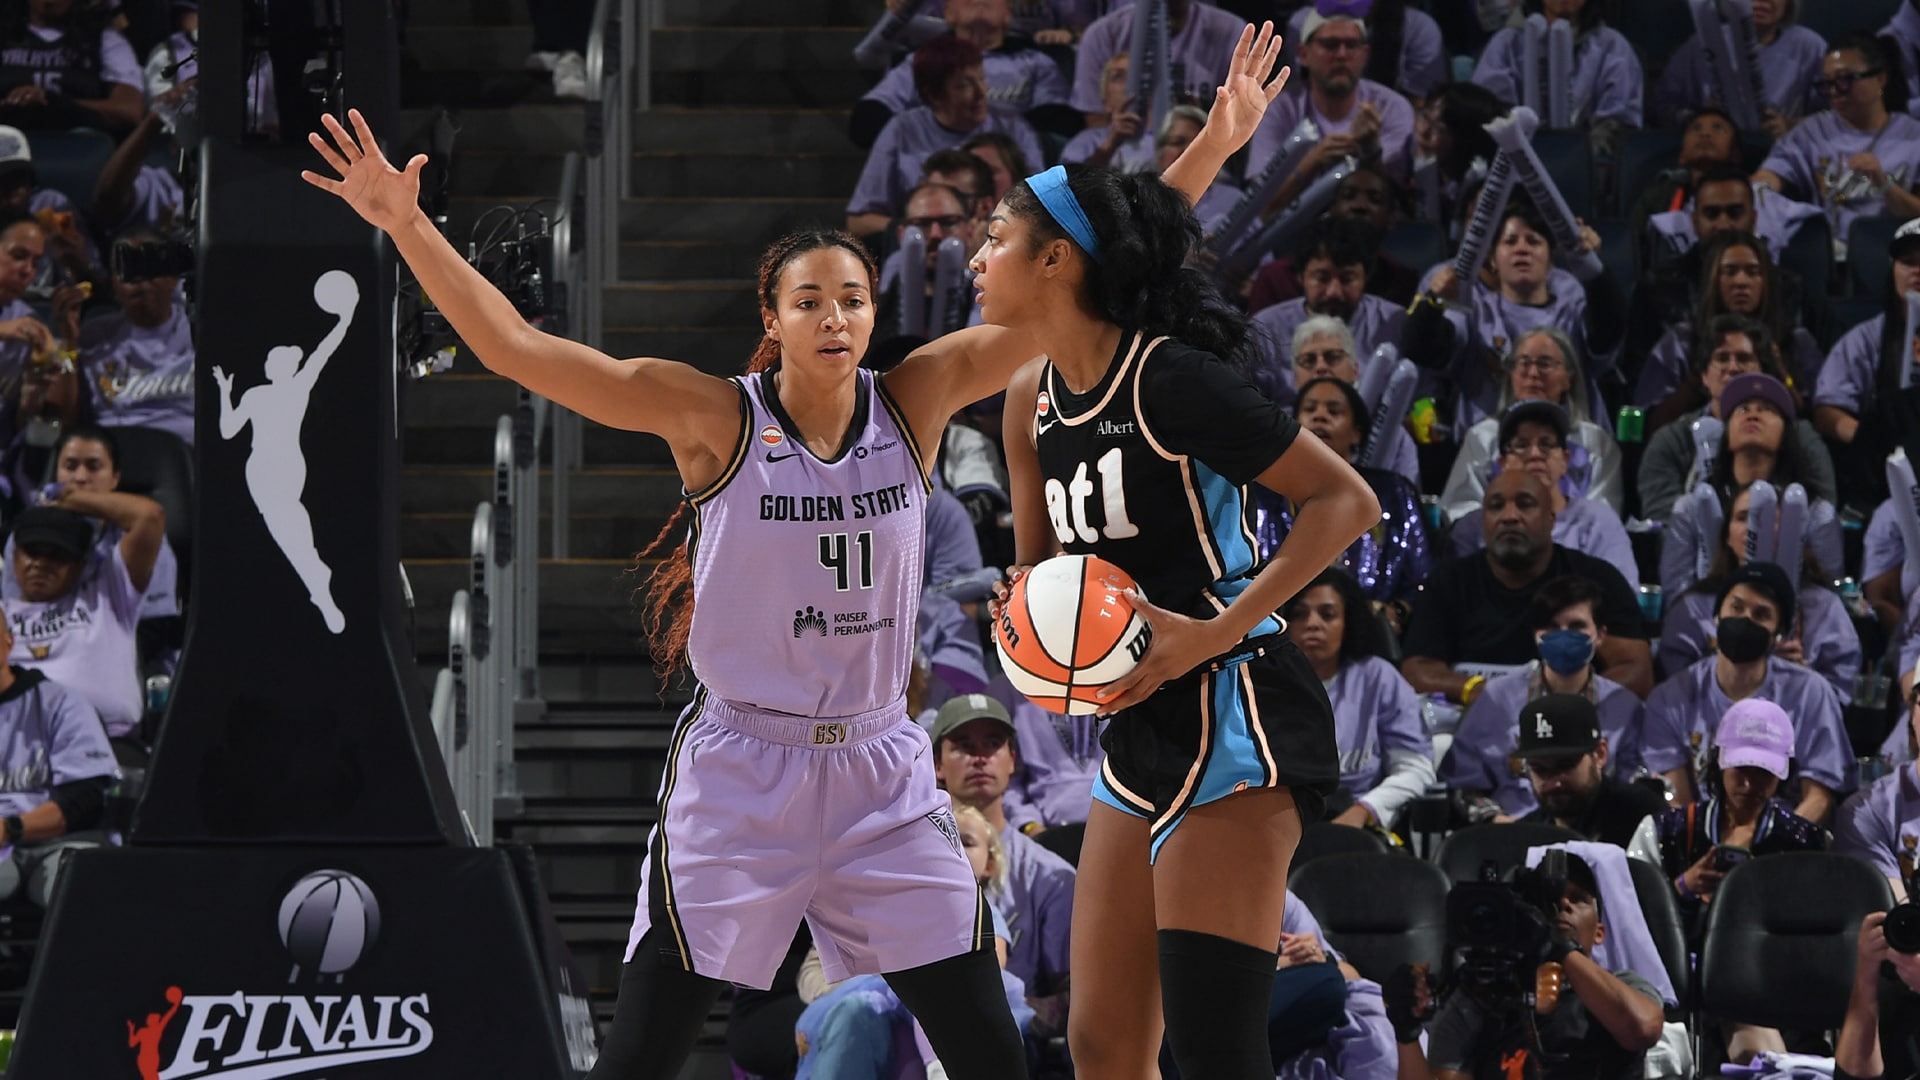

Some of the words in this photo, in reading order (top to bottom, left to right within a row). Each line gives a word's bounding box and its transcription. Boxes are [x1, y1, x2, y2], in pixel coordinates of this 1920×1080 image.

[1096, 420, 1135, 435] Albert
[760, 494, 845, 522] GOLDEN
[851, 483, 910, 519] STATE
[818, 530, 874, 592] 41
[834, 611, 868, 623] KAISER
[834, 617, 895, 636] PERMANENTE
[813, 722, 847, 744] GSV
[1535, 712, 1553, 738] LA
[158, 990, 434, 1080] FINALS
